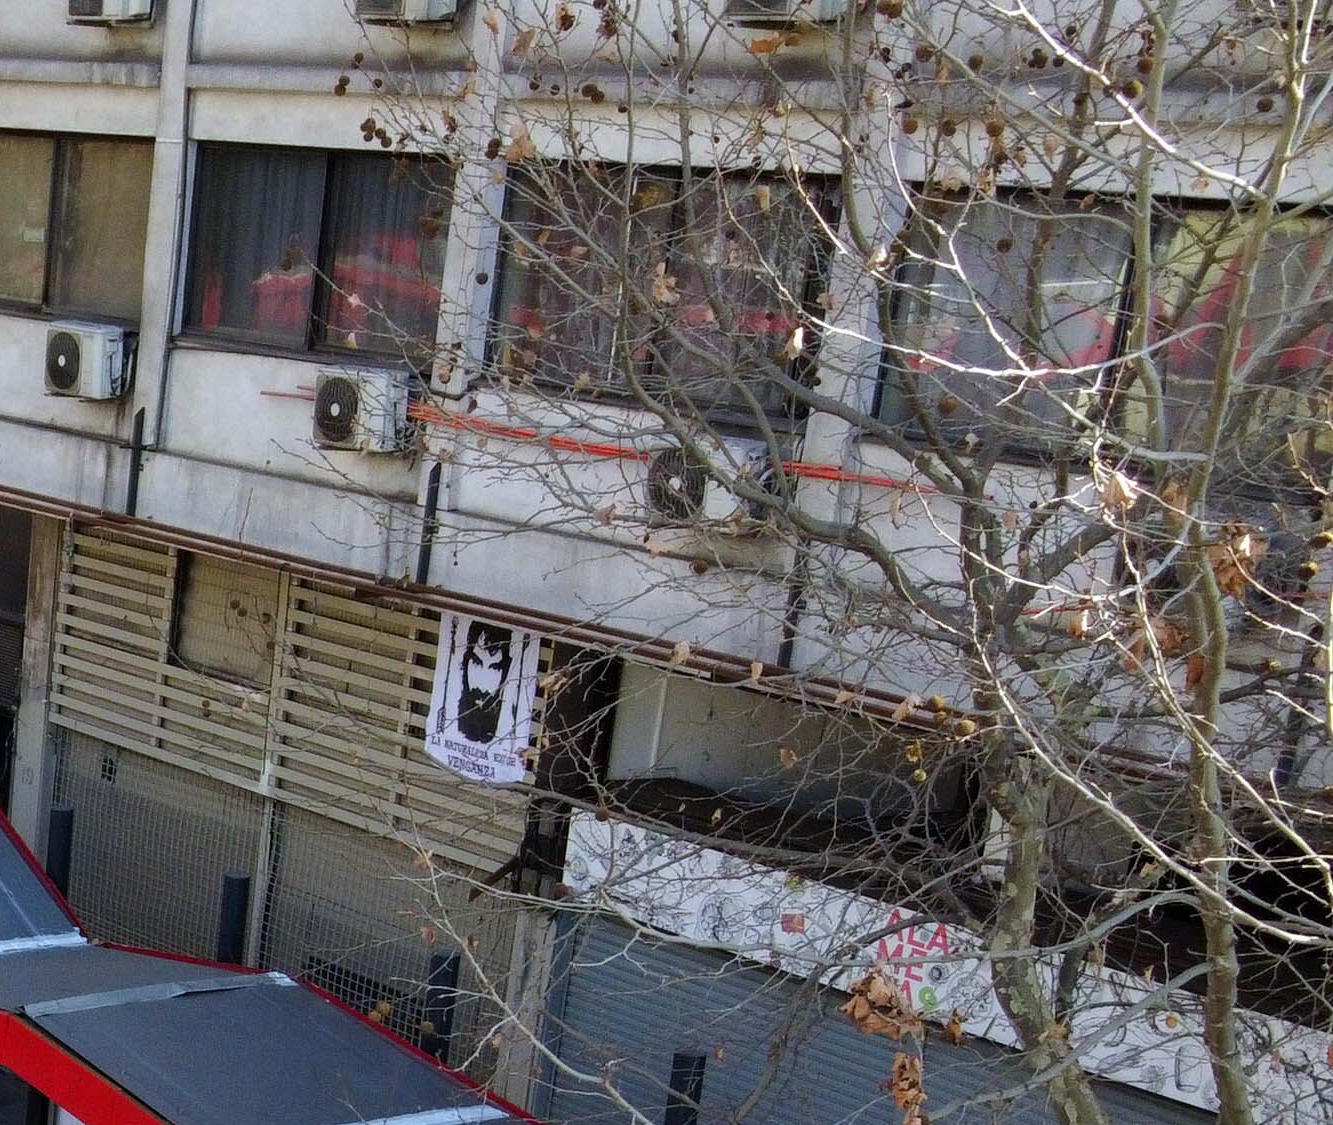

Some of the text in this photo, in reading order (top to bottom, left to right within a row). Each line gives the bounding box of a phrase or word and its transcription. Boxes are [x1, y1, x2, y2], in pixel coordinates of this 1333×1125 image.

[431, 735, 441, 746] LA
[444, 739, 488, 761] NATURALEZA
[447, 755, 496, 778] VENGANZA
